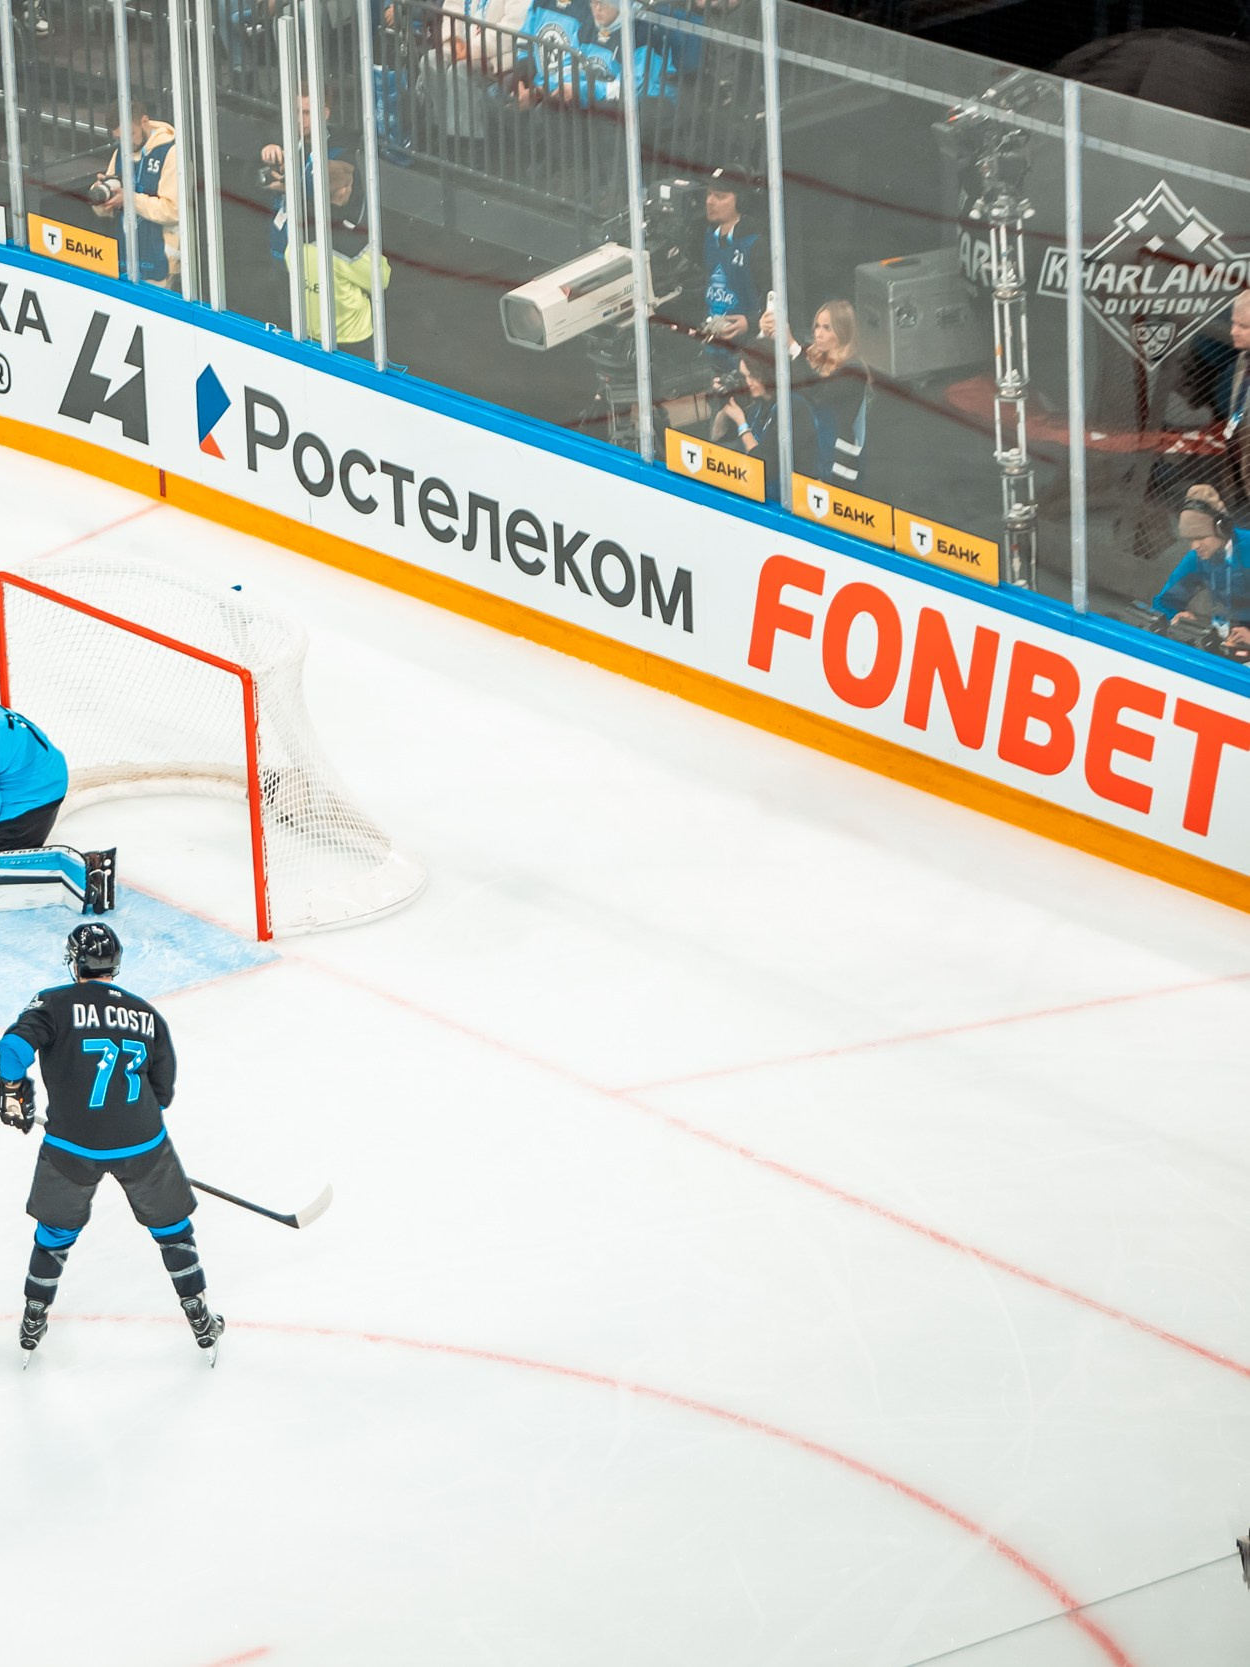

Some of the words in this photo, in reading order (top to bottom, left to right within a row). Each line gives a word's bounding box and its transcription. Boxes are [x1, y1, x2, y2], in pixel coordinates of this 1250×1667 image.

[65, 238, 104, 261] БАНК
[732, 249, 744, 267] 21
[1045, 253, 1250, 294] KHARLAMO
[1103, 296, 1211, 315] DIVISION
[706, 456, 748, 482] БАНК
[243, 384, 695, 635] Ростелеком
[833, 502, 876, 528] БАНК
[937, 538, 981, 566] БАНК
[748, 554, 1250, 837] FONBET
[73, 1003, 100, 1028] DA
[104, 1004, 155, 1038] COSTA
[82, 1038, 148, 1108] 77
